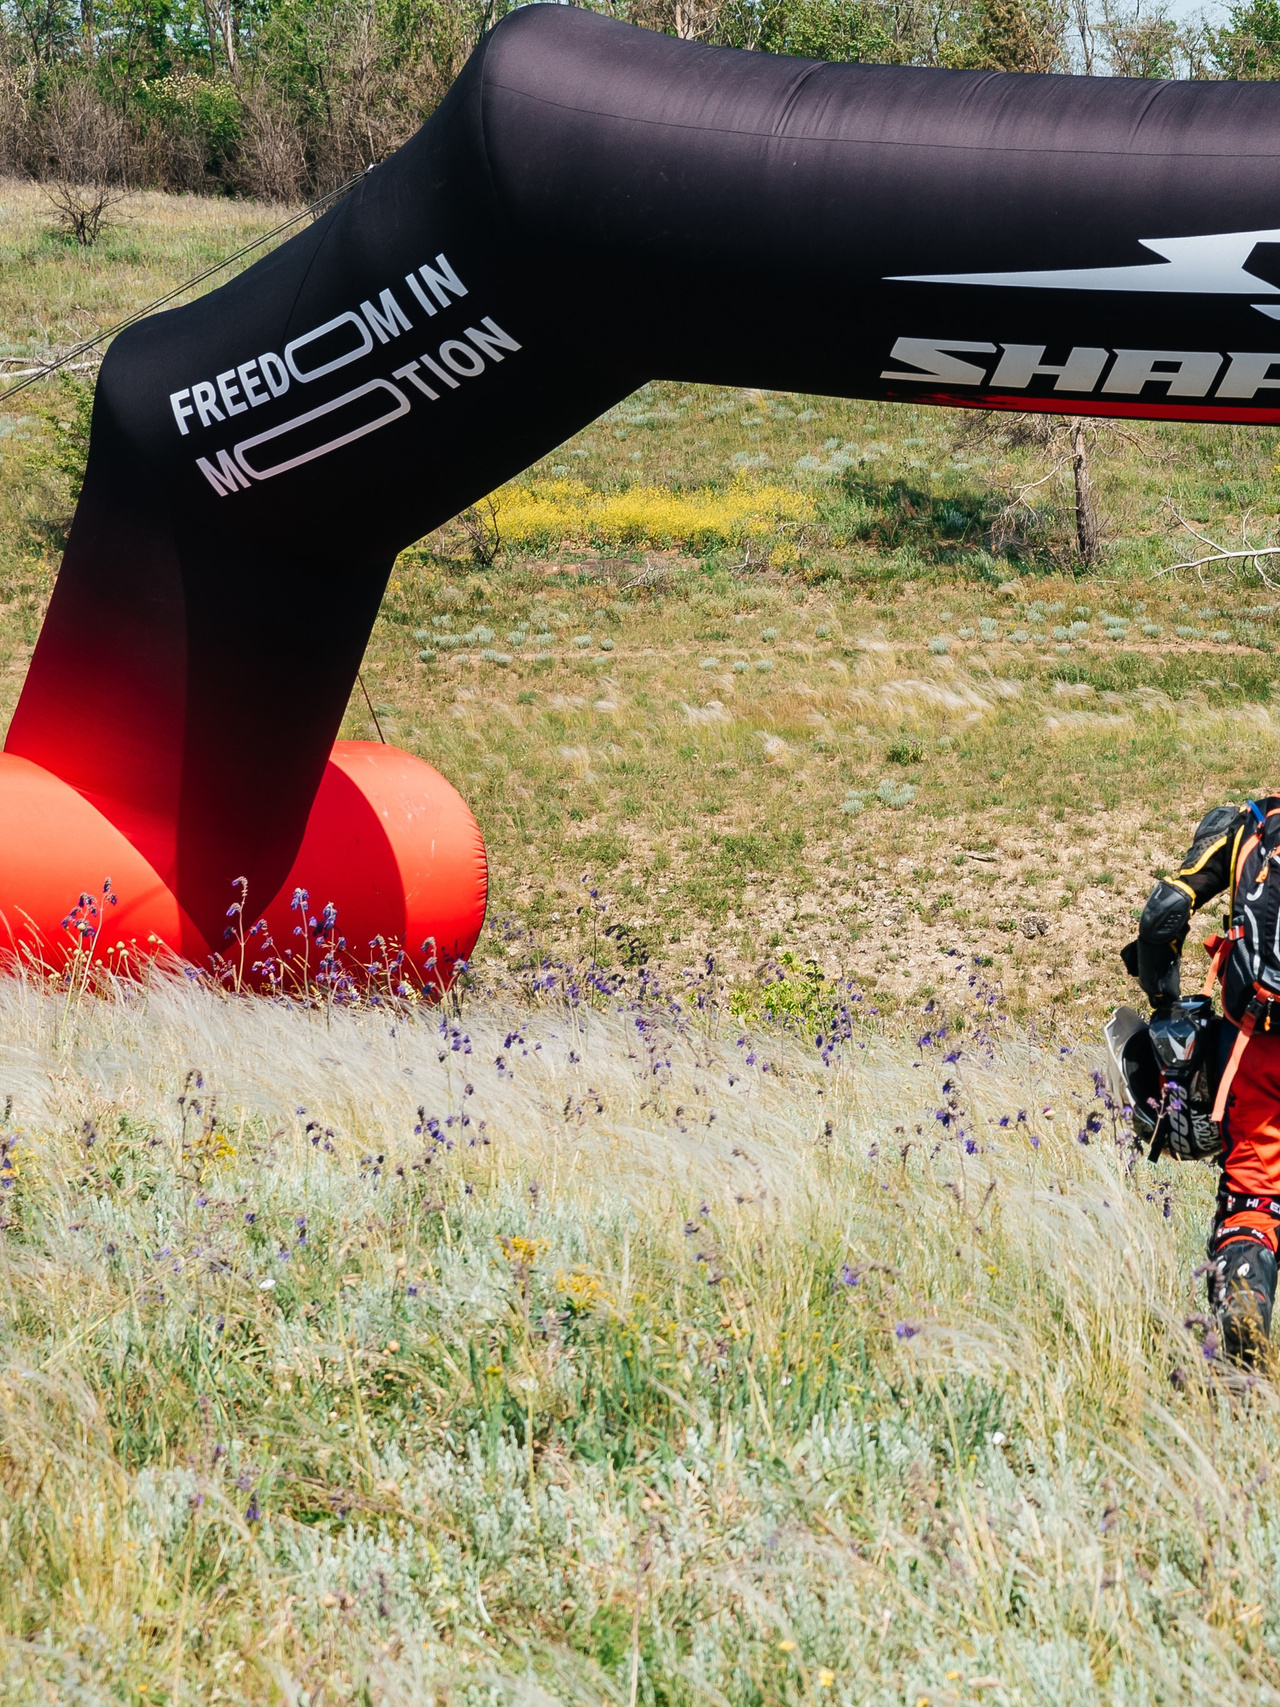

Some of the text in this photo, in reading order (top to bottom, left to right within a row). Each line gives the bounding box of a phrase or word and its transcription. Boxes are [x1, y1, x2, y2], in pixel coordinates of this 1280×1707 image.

[169, 253, 468, 435] FREEDOM IN
[196, 316, 522, 496] MOTION
